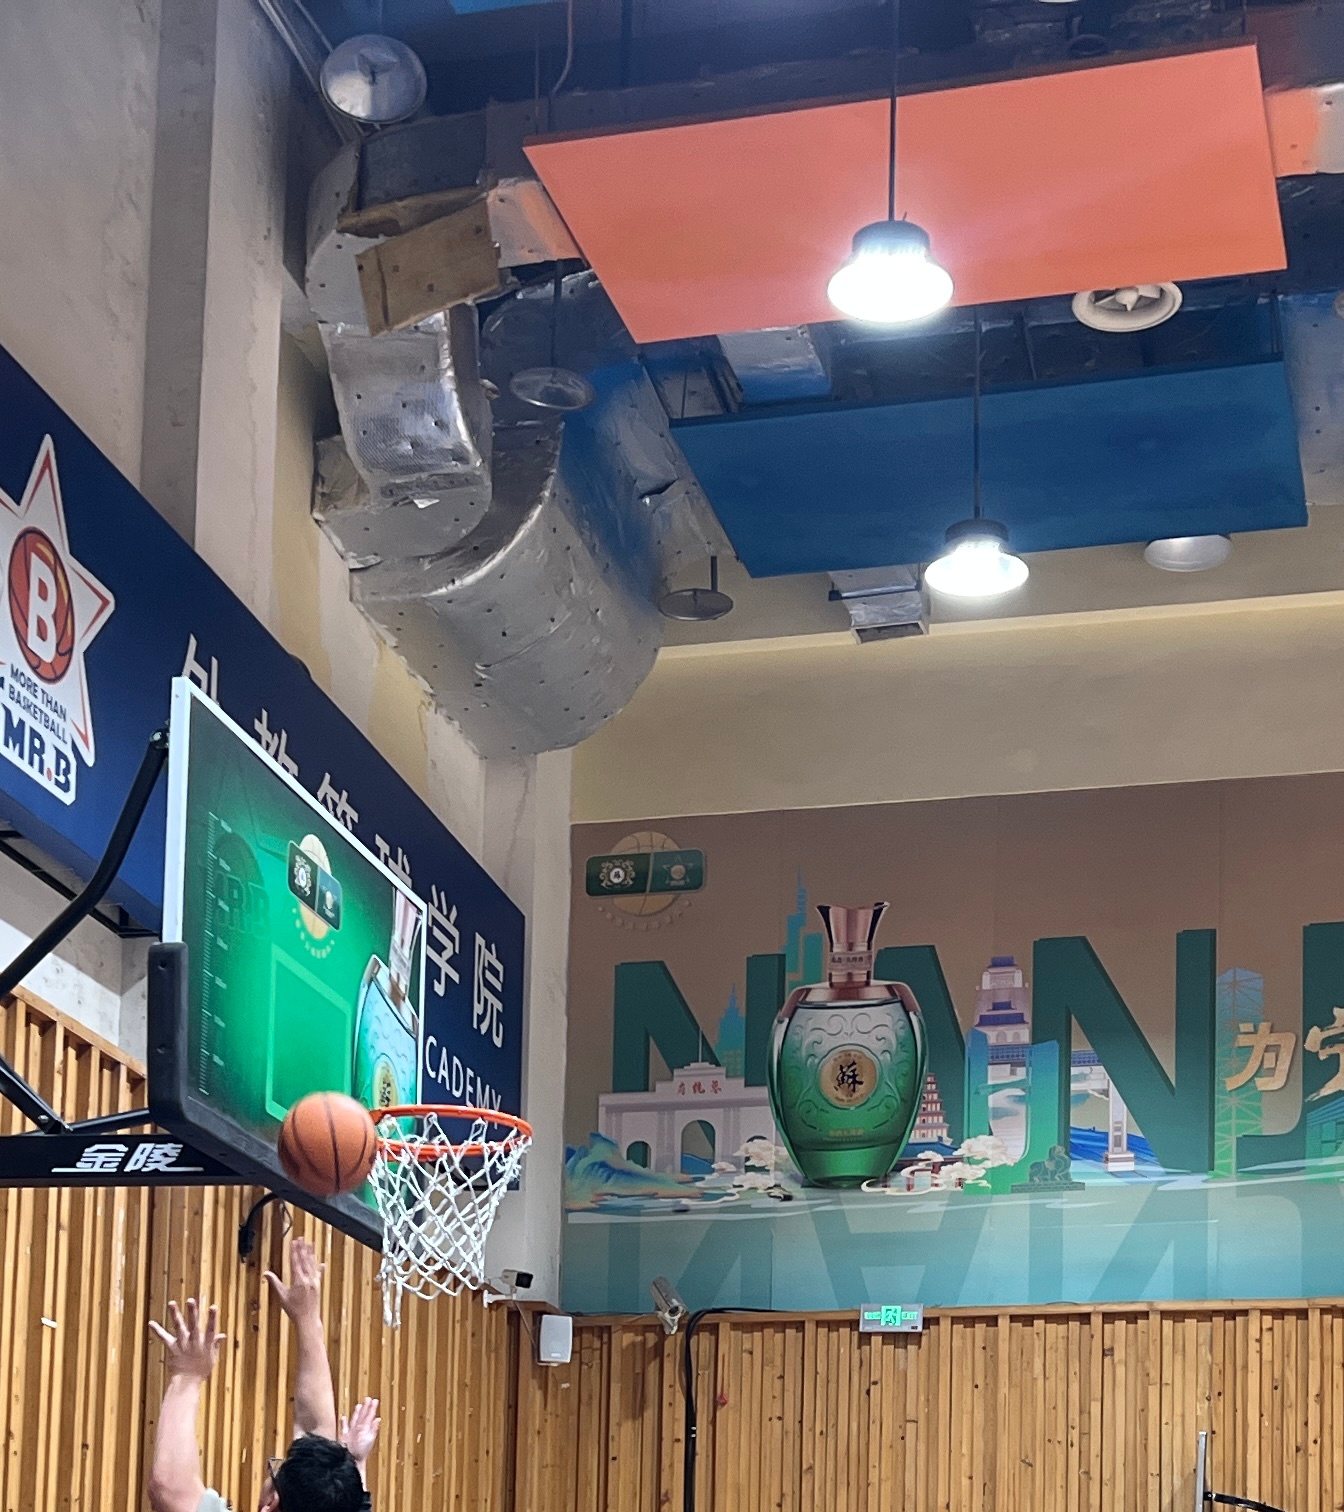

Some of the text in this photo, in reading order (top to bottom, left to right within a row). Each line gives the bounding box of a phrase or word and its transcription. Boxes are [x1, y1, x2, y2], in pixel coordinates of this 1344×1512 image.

[27, 551, 56, 664] B
[8, 683, 68, 745] BASKETBALL
[10, 663, 67, 722] MORE THAN
[2, 703, 72, 794] MR.B
[425, 1035, 502, 1130] CADEMY
[74, 1142, 184, 1173] 金陵
